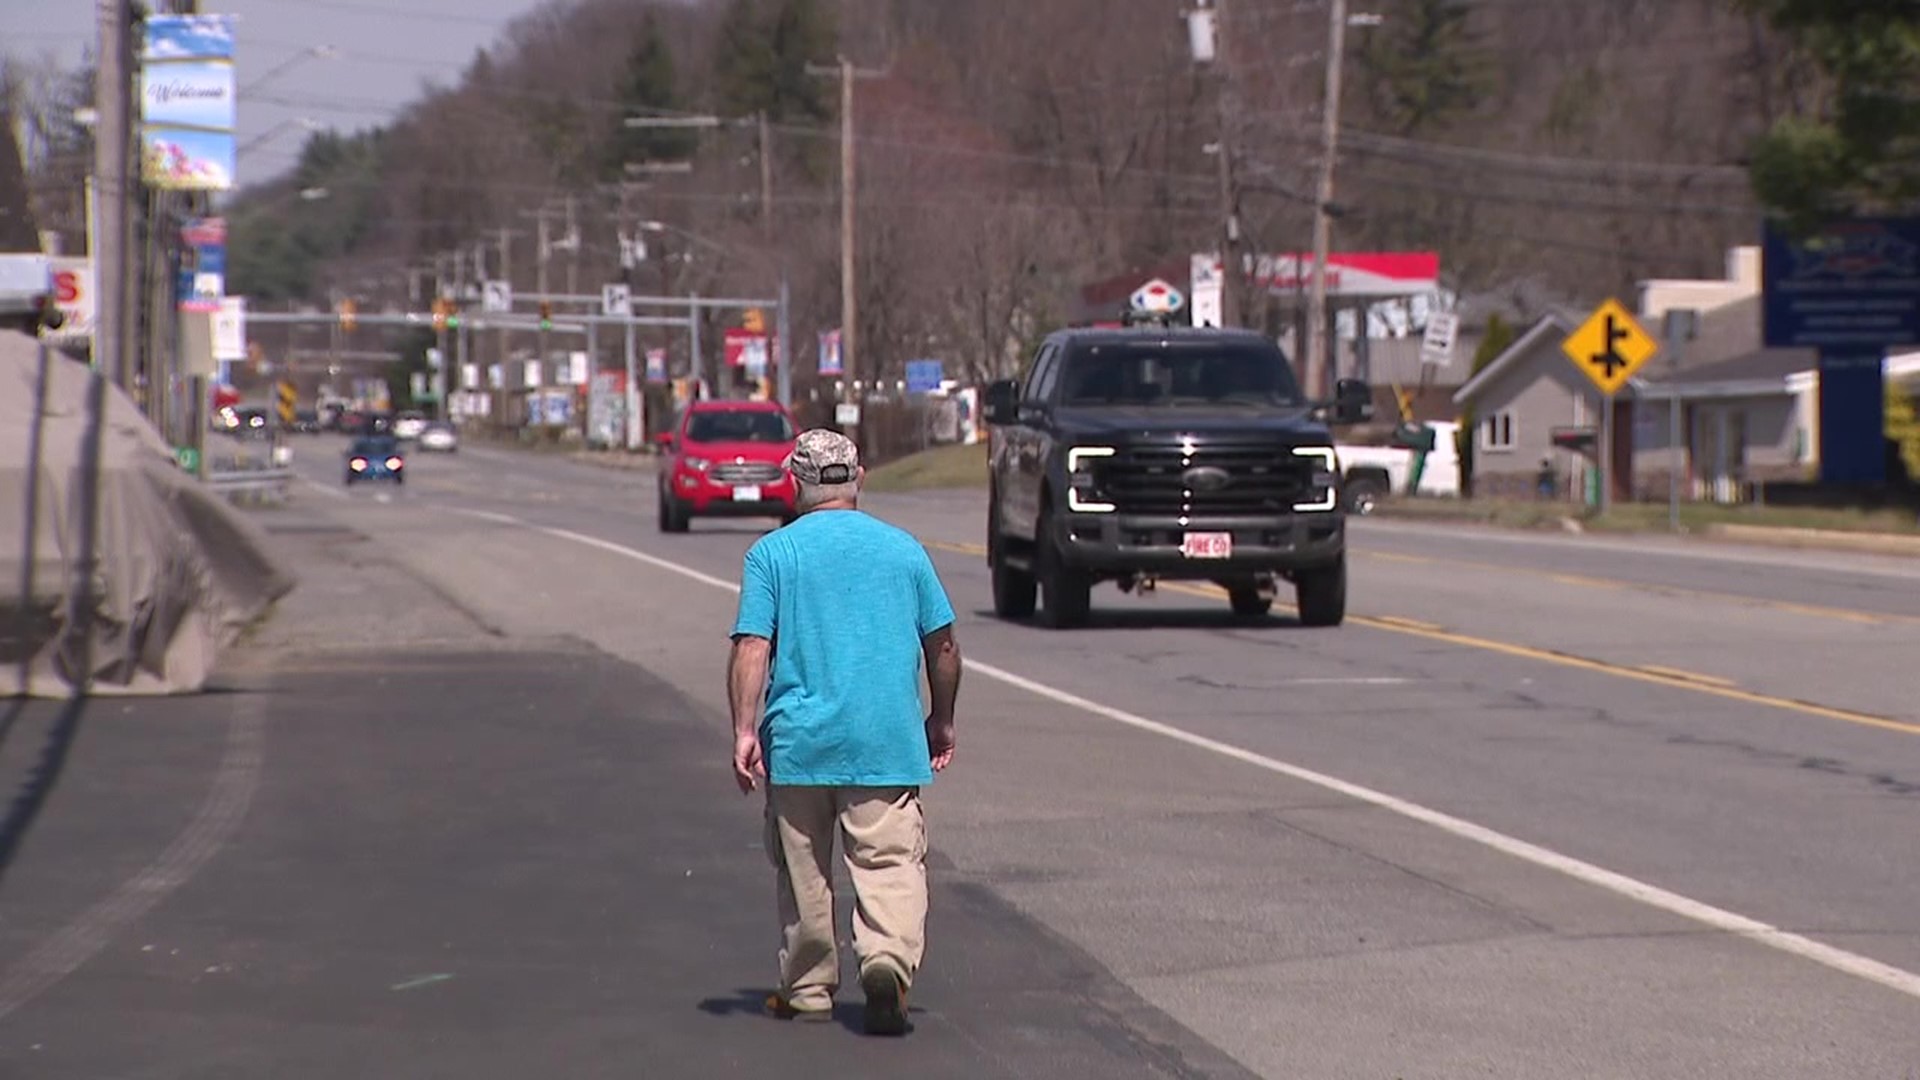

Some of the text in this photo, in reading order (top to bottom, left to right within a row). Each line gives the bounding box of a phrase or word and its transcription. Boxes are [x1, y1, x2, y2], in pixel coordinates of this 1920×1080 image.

[147, 79, 225, 104] Welcome
[1185, 538, 1228, 554] FIRE CO
